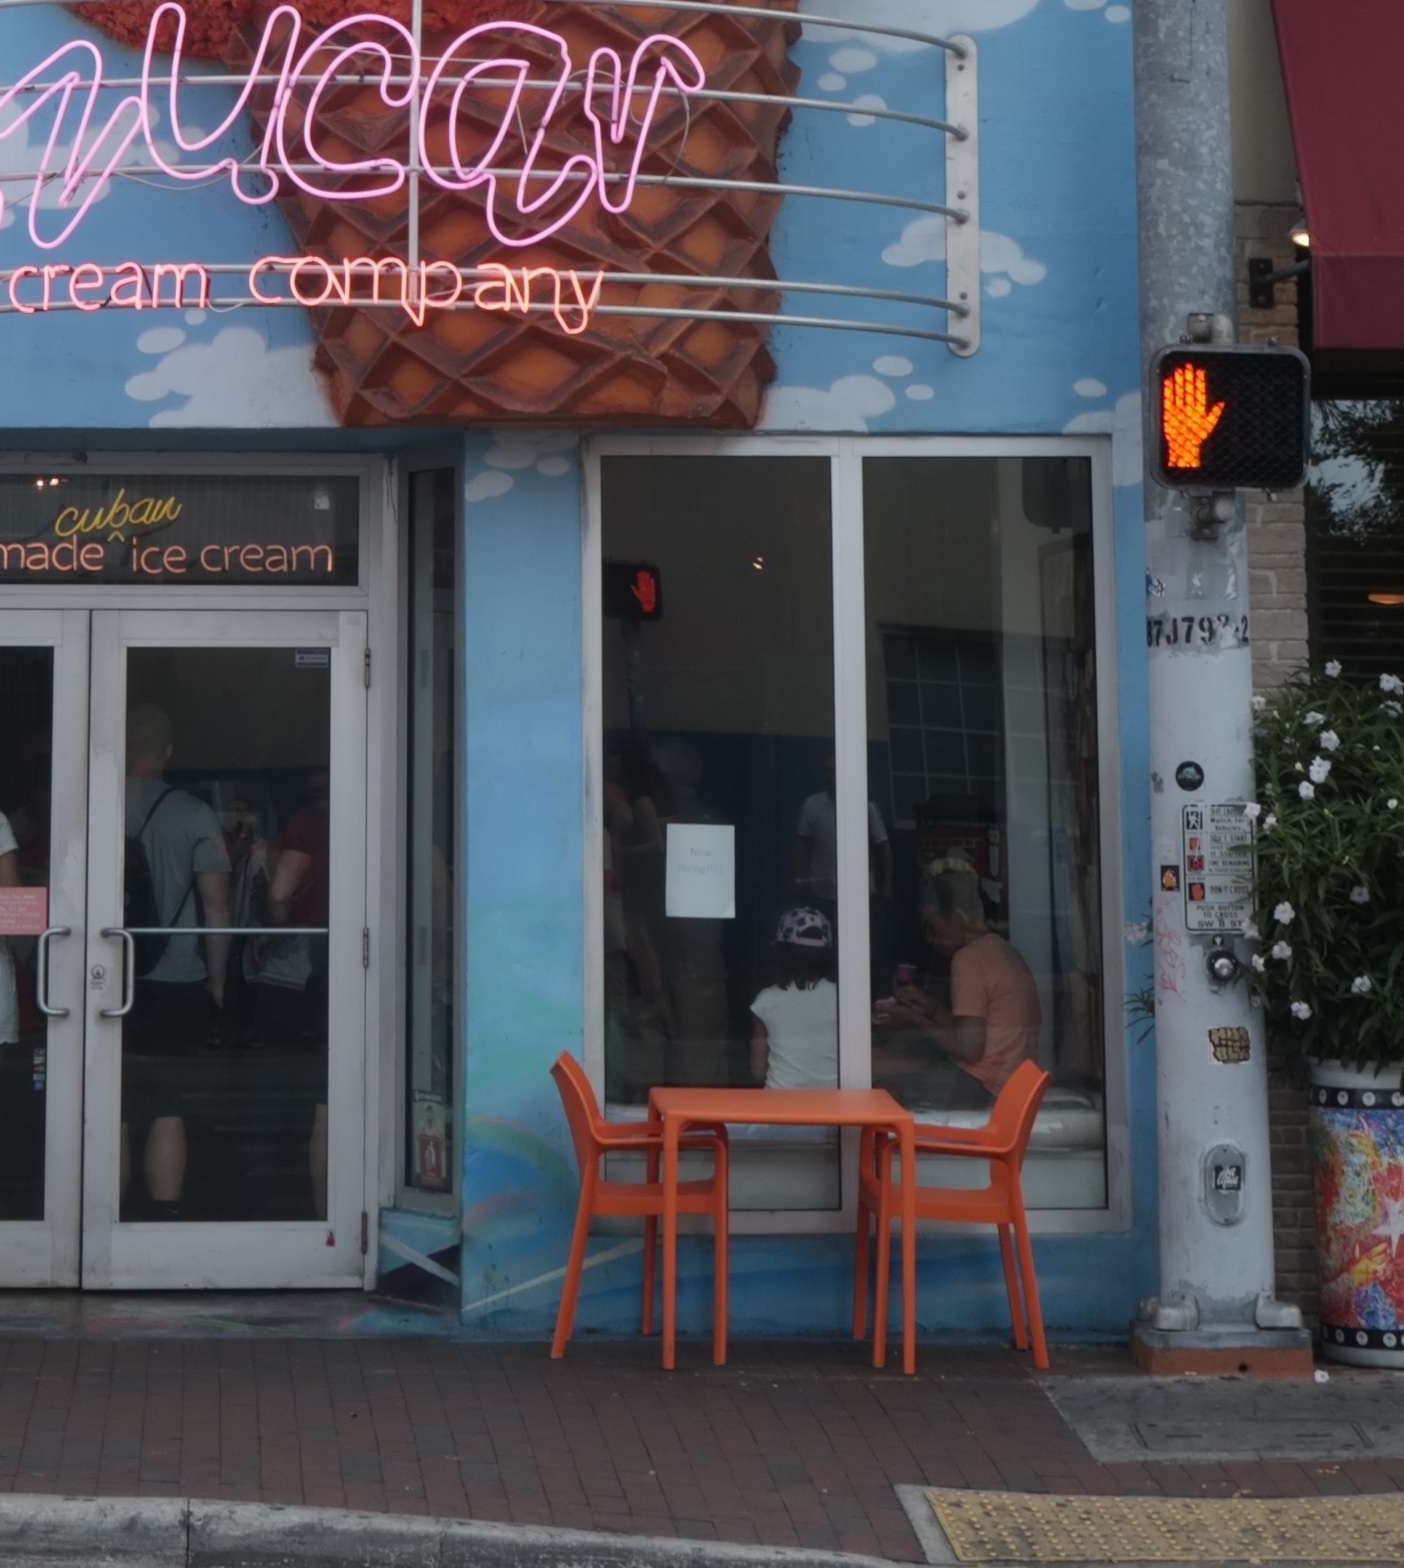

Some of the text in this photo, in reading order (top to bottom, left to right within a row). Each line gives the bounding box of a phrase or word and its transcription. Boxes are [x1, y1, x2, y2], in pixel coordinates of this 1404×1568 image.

[8, 261, 211, 312] cream
[248, 255, 604, 335] company
[54, 487, 183, 538] cuban
[131, 536, 188, 574] ice
[199, 542, 334, 574] cream
[1197, 920, 1214, 928] SW
